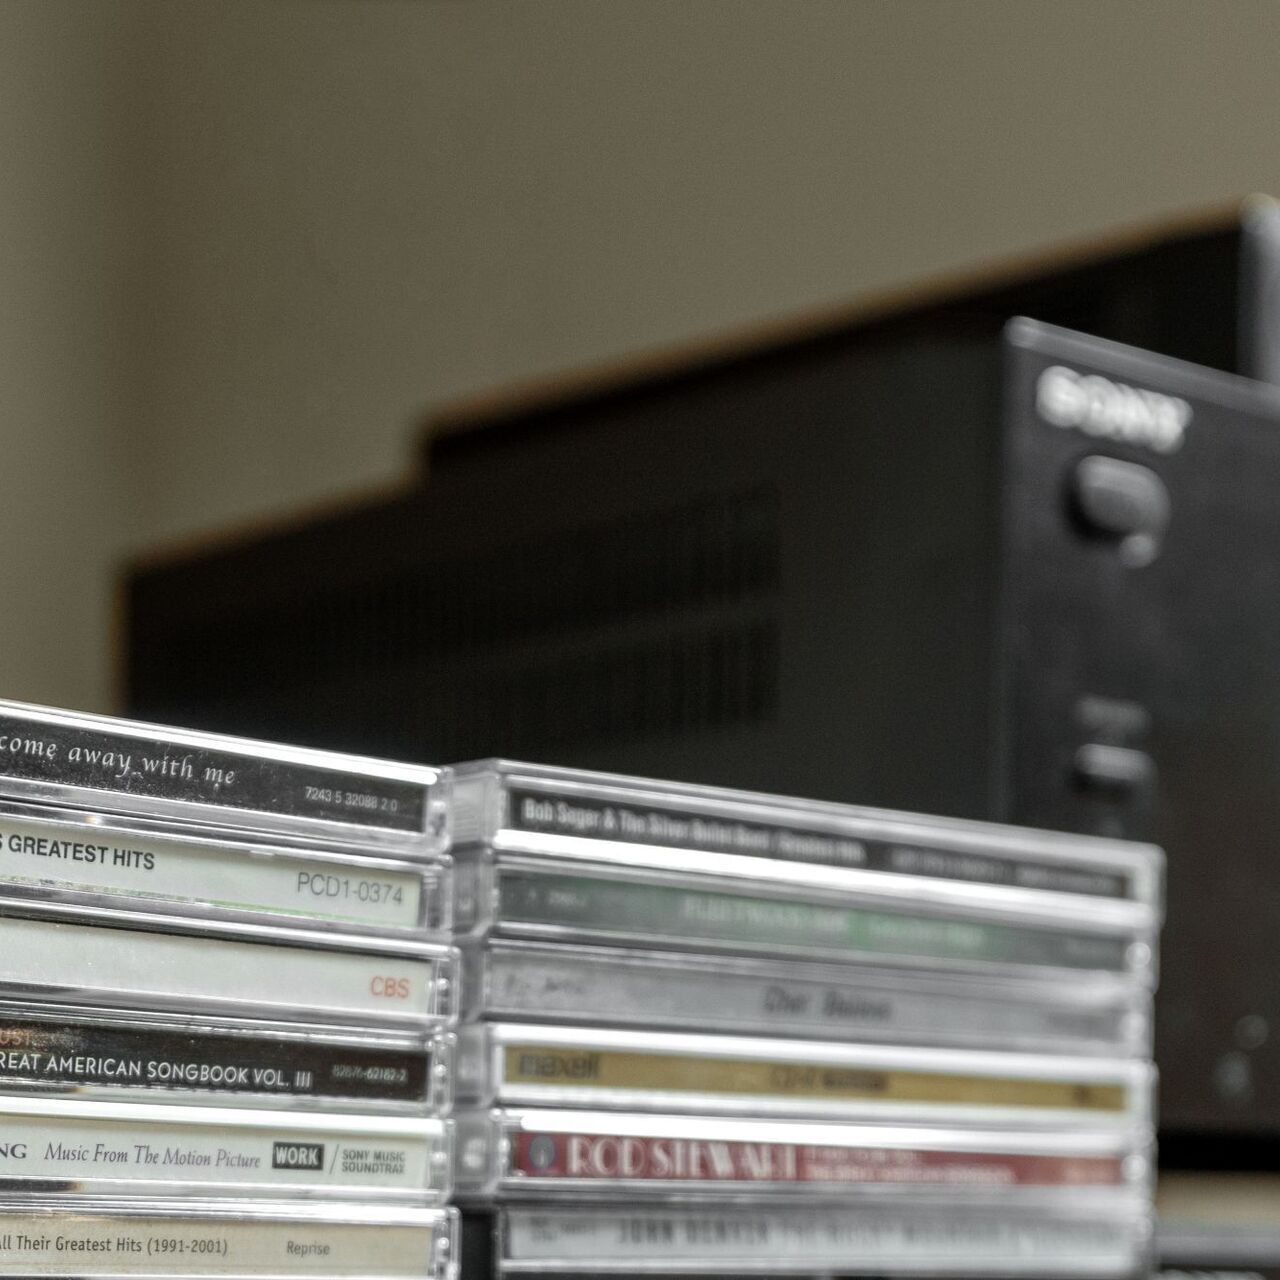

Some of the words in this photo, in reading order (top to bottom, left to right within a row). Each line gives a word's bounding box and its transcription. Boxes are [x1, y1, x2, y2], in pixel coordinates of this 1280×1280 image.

[68, 746, 131, 779] away
[141, 754, 194, 779] with
[205, 767, 237, 785] me
[306, 786, 332, 803] 7243
[335, 790, 342, 804] 5
[381, 798, 387, 811] 2
[390, 799, 398, 812] 0
[8, 834, 109, 864] GREATEST
[113, 848, 155, 870] HITS
[297, 871, 404, 905] PCD1-0374
[370, 976, 410, 999] CBS
[46, 1055, 141, 1078] AMERICAN
[147, 1063, 248, 1085] SONGBOOK
[253, 1067, 289, 1088] VOL.
[295, 1072, 312, 1089] III
[44, 1141, 88, 1164] Music
[94, 1144, 129, 1165] From
[134, 1145, 159, 1166] The
[162, 1146, 212, 1168] Motion
[215, 1148, 261, 1170] Picture
[275, 1145, 320, 1168] WORK
[342, 1149, 370, 1161] SONY
[373, 1151, 406, 1162] MUSIC
[16, 1235, 51, 1252] Their
[55, 1236, 112, 1254] Greatest
[116, 1237, 143, 1253] Hits
[147, 1236, 229, 1257] (1991-2001)
[287, 1240, 331, 1257] Reprise
